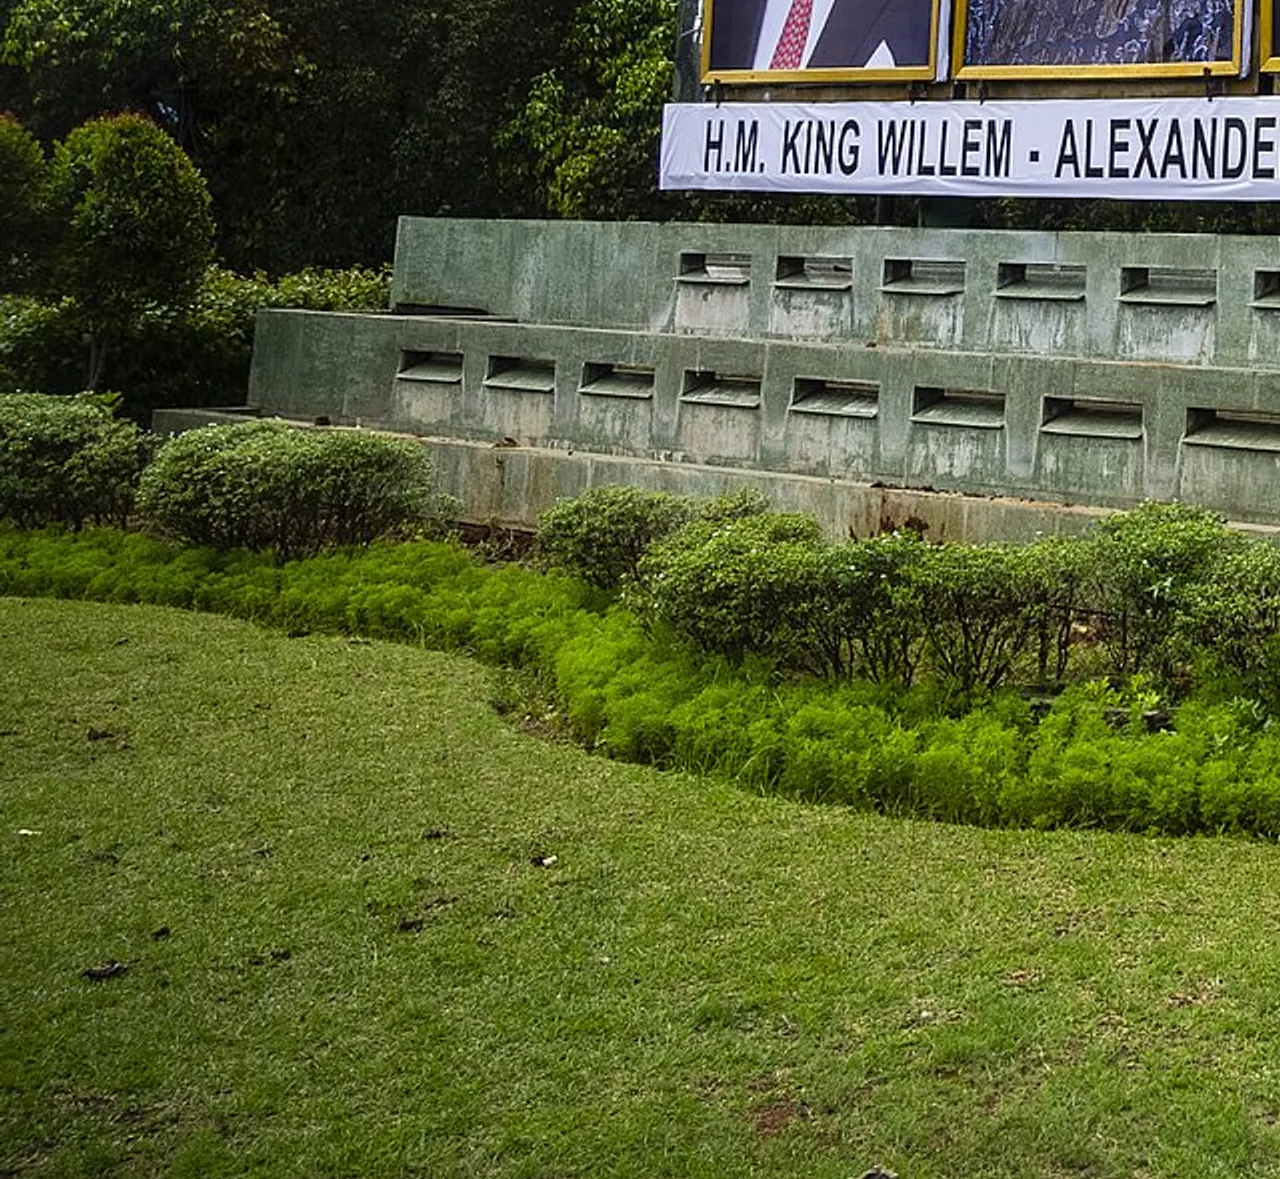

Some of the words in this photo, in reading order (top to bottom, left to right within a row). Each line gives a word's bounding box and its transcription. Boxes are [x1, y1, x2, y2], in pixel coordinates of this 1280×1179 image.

[703, 119, 763, 174] H.M.
[781, 119, 860, 176] KING
[877, 119, 1012, 178] WILLEM
